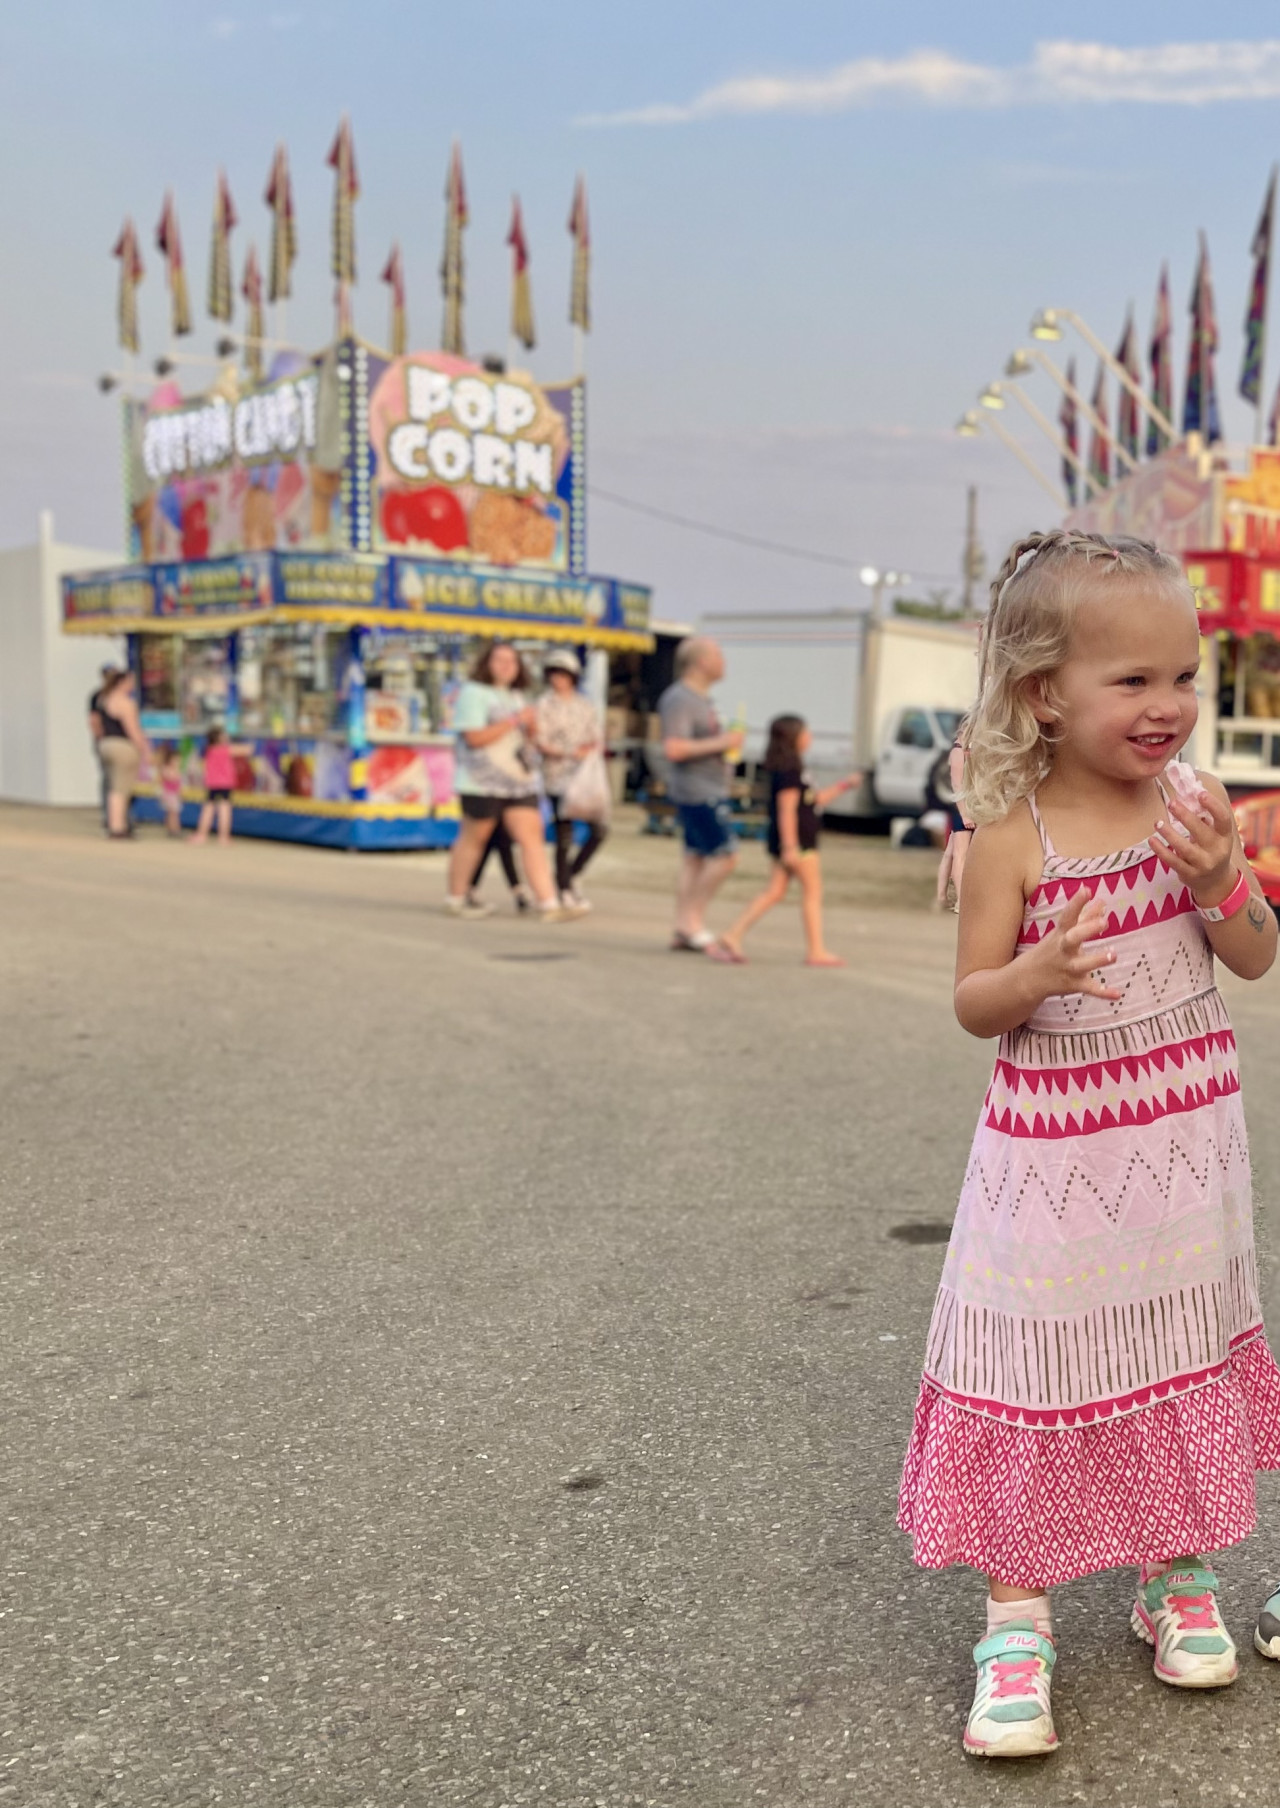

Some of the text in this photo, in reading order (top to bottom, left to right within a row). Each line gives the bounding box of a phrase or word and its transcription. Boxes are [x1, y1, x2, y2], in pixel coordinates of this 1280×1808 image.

[407, 365, 536, 436] POP
[389, 422, 553, 494] CORN
[423, 571, 477, 609] ICE
[1167, 1572, 1195, 1587] FILA
[1005, 1635, 1038, 1648] FILA
